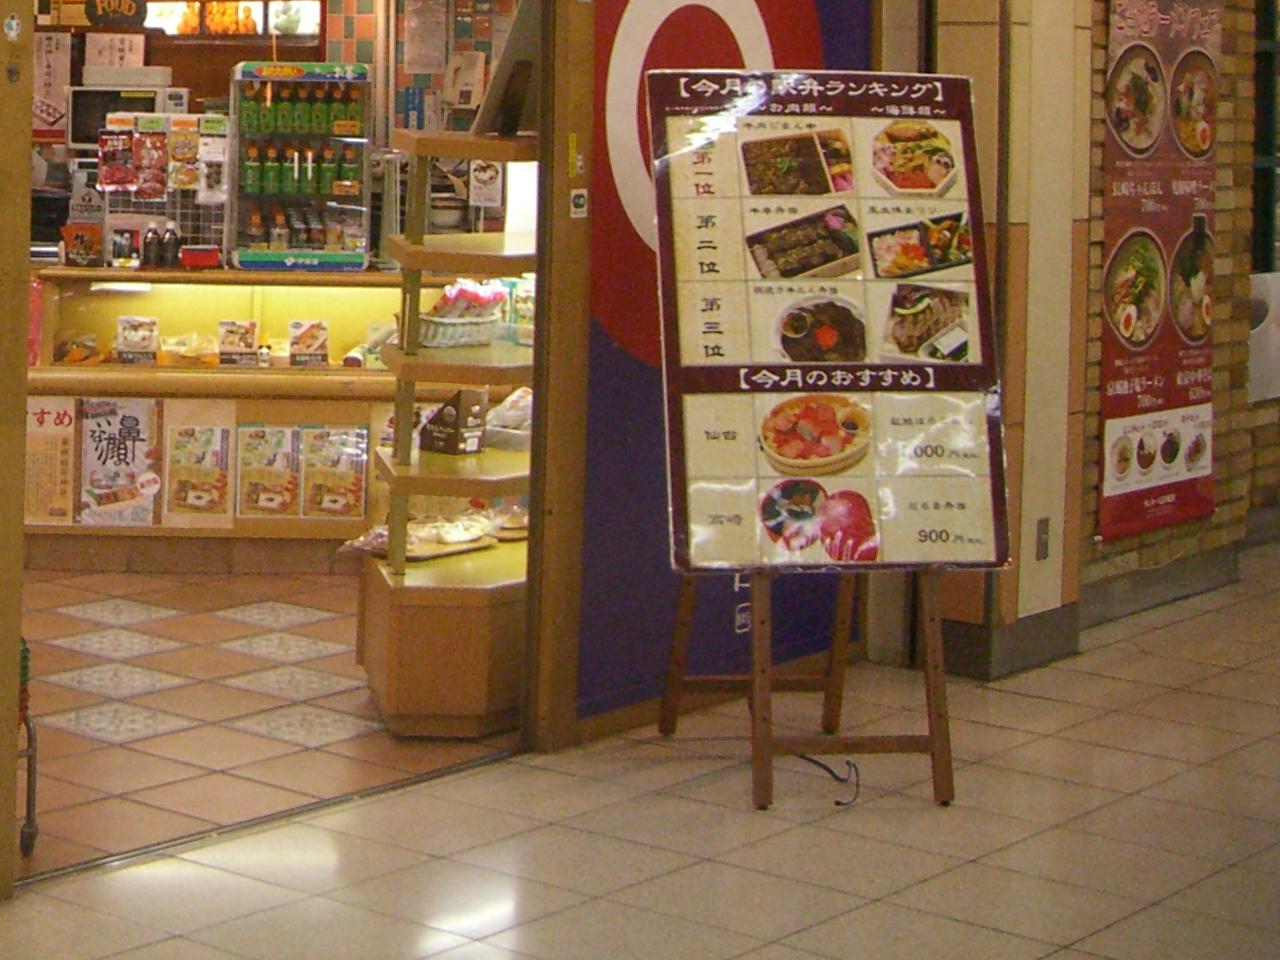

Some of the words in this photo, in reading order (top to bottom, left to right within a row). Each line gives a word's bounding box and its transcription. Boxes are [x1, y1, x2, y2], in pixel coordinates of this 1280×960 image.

[696, 214, 721, 275] 第二位
[701, 297, 725, 359] 第三位
[739, 368, 935, 390] 【今月のおすすめ】
